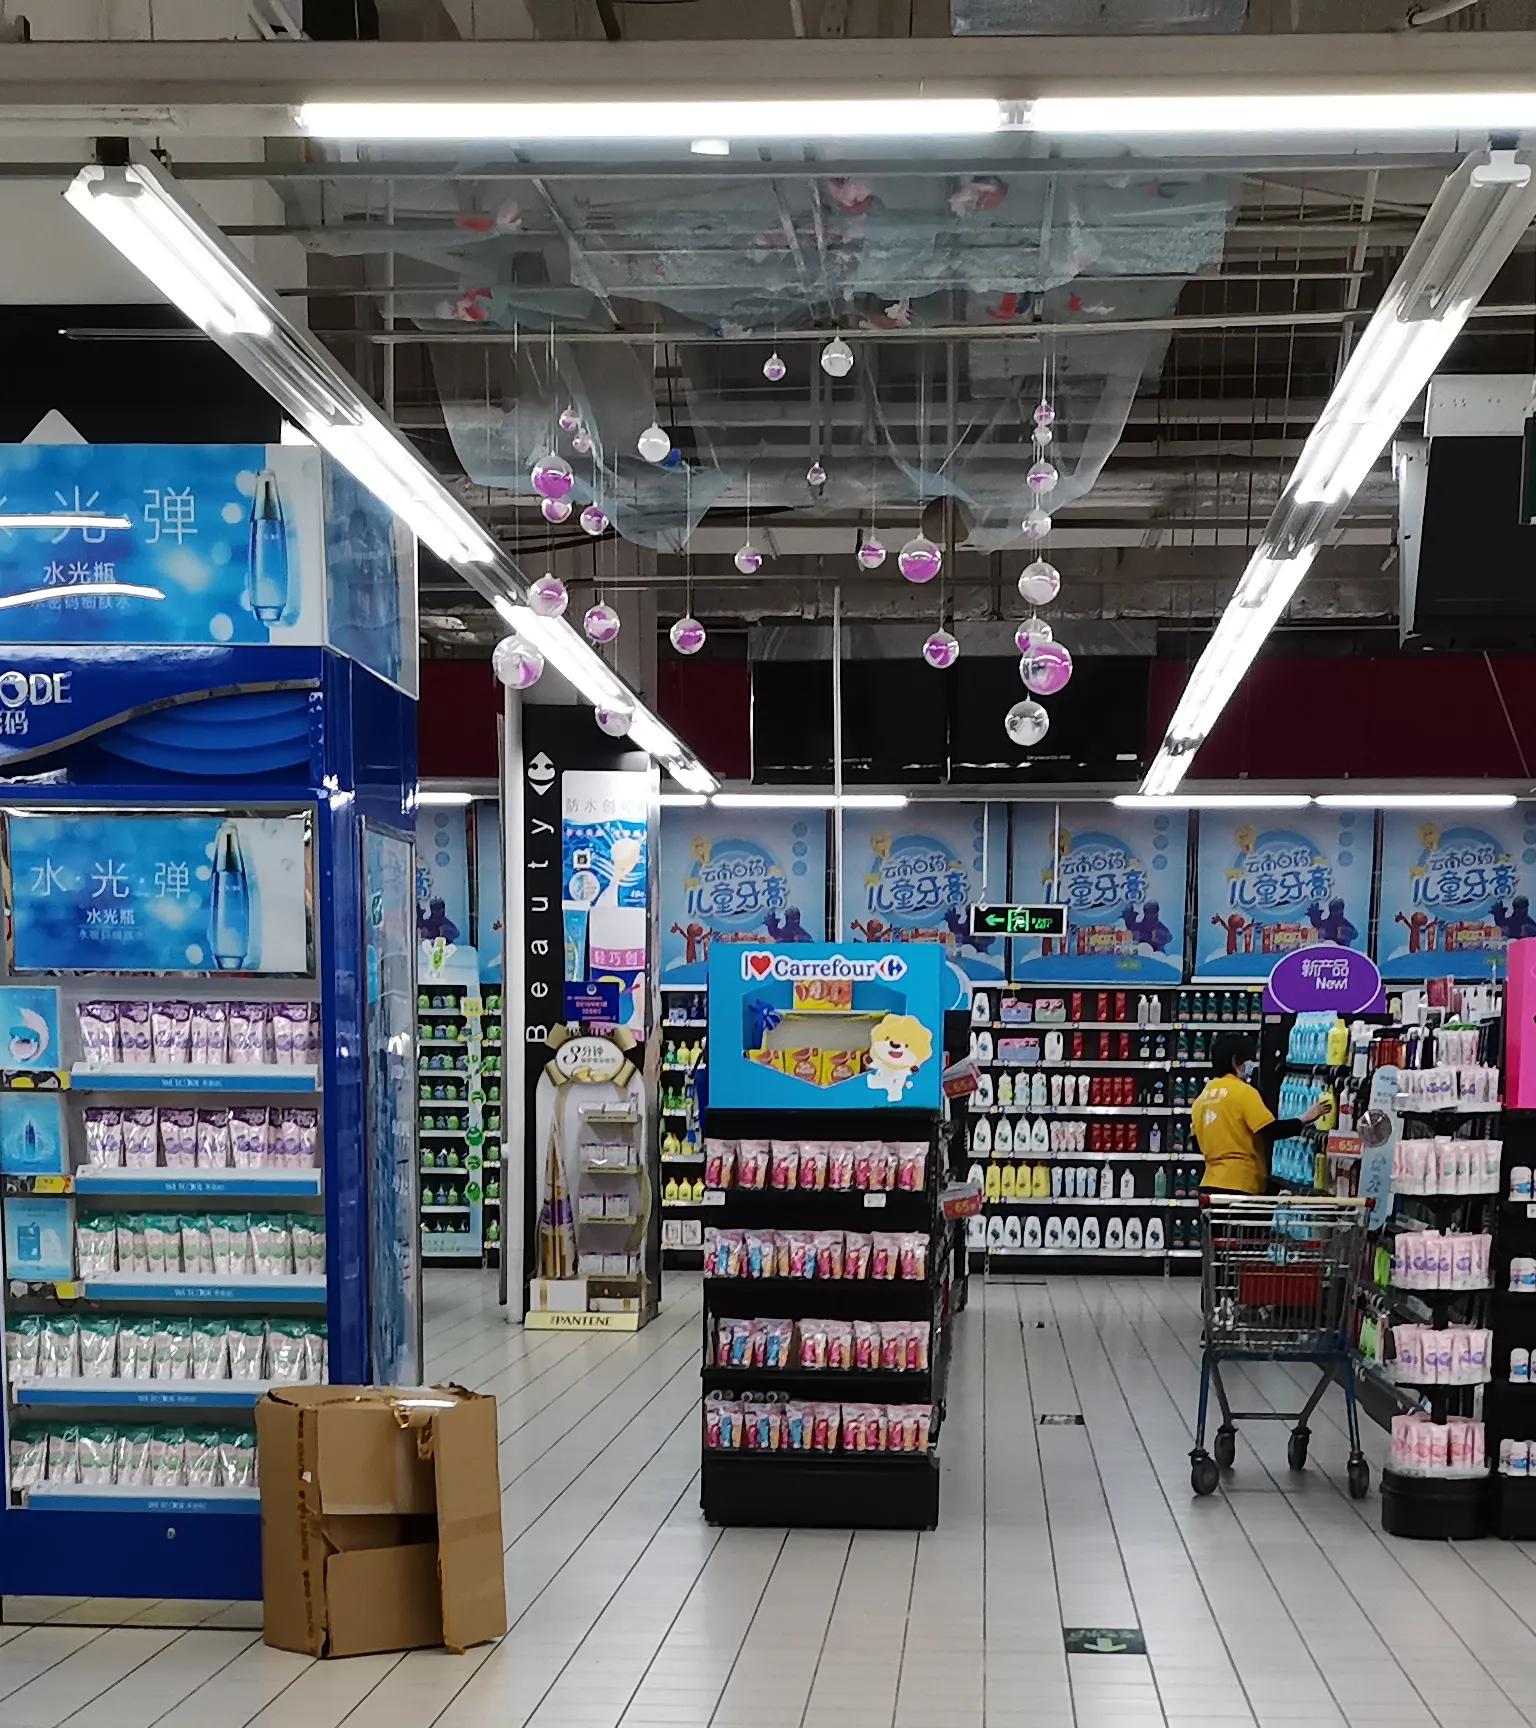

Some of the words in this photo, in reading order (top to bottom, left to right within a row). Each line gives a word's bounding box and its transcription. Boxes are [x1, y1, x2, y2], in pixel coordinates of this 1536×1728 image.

[686, 875, 788, 914] 儿童牙膏
[867, 870, 969, 911] 儿童牙膏
[1044, 868, 1147, 907] 儿童牙膏
[1229, 867, 1333, 907] 儿童牙膏
[1413, 864, 1519, 905] 儿童牙膏
[526, 818, 554, 1043] Beauty
[774, 957, 876, 977] Carrefour
